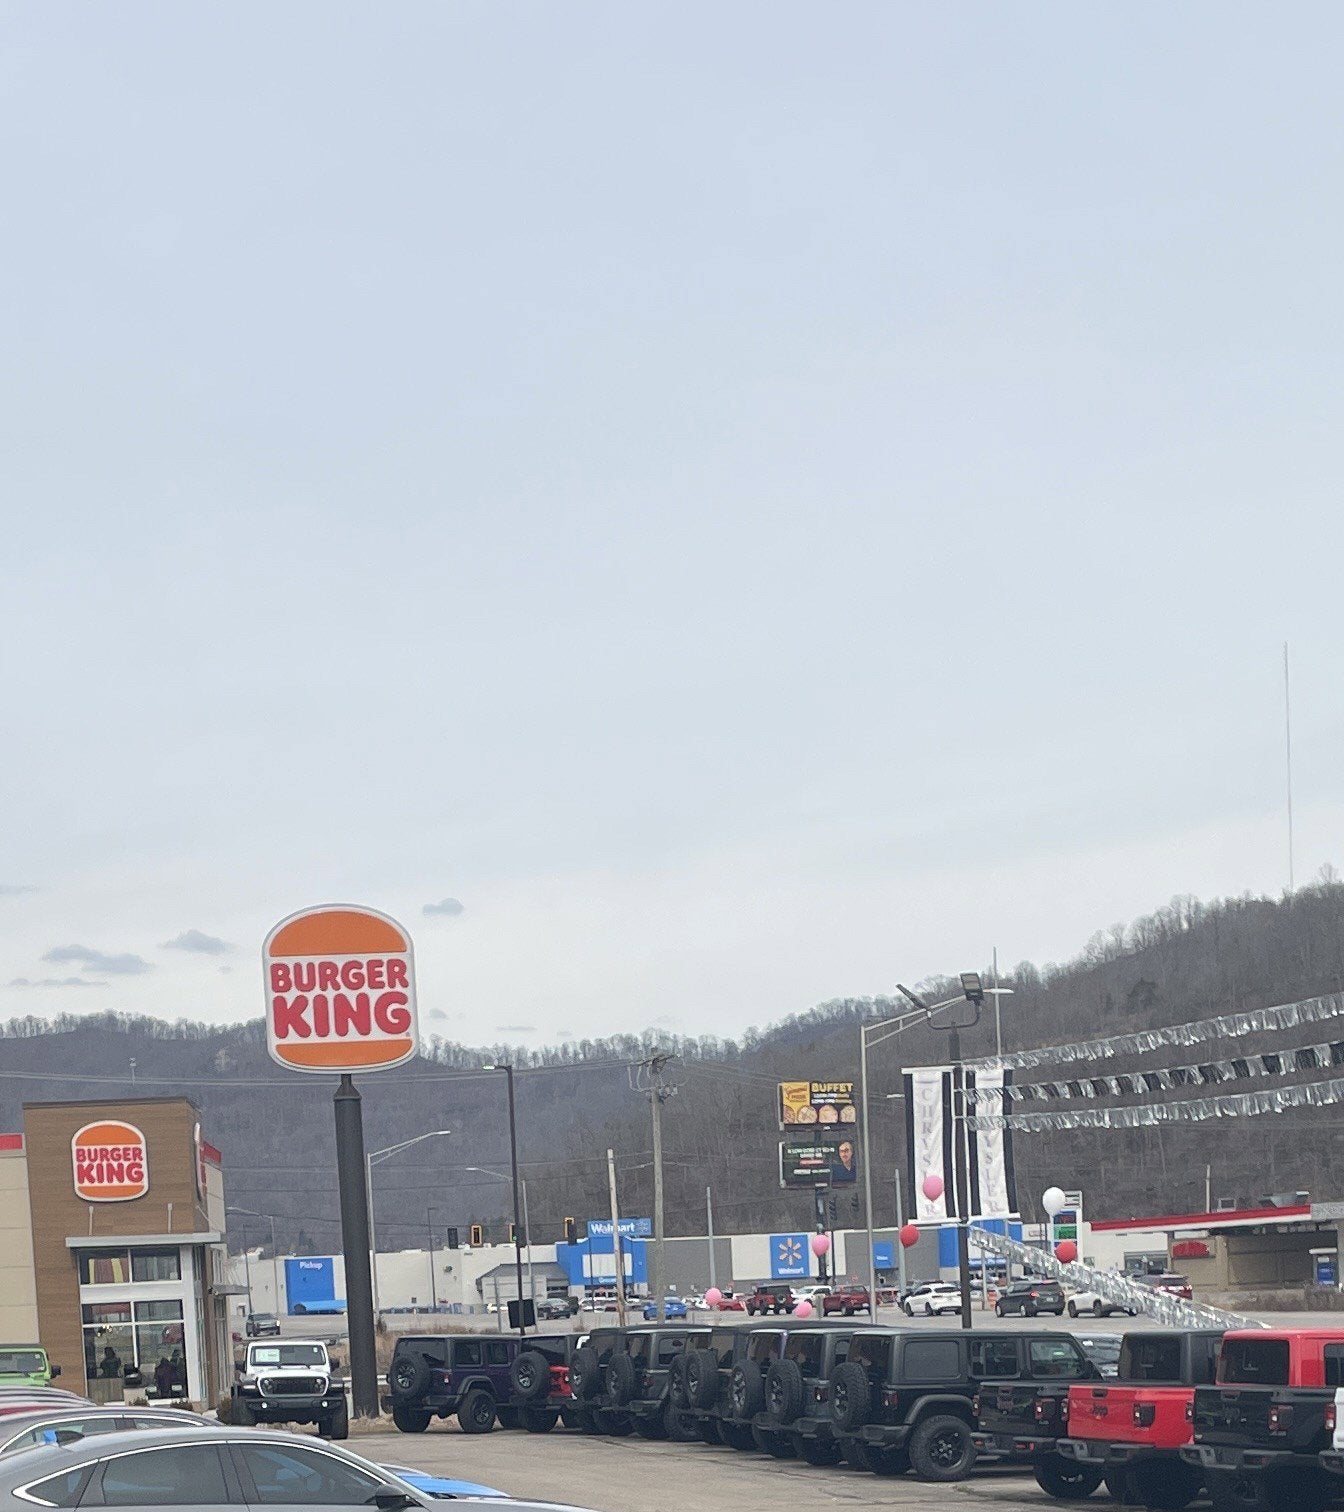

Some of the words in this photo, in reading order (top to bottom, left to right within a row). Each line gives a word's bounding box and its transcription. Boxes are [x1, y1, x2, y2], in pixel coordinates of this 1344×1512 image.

[270, 958, 409, 993] BURGER
[272, 991, 412, 1039] KING
[811, 1082, 854, 1093] BUFFET
[76, 1147, 144, 1163] BURGER
[77, 1162, 145, 1184] KING
